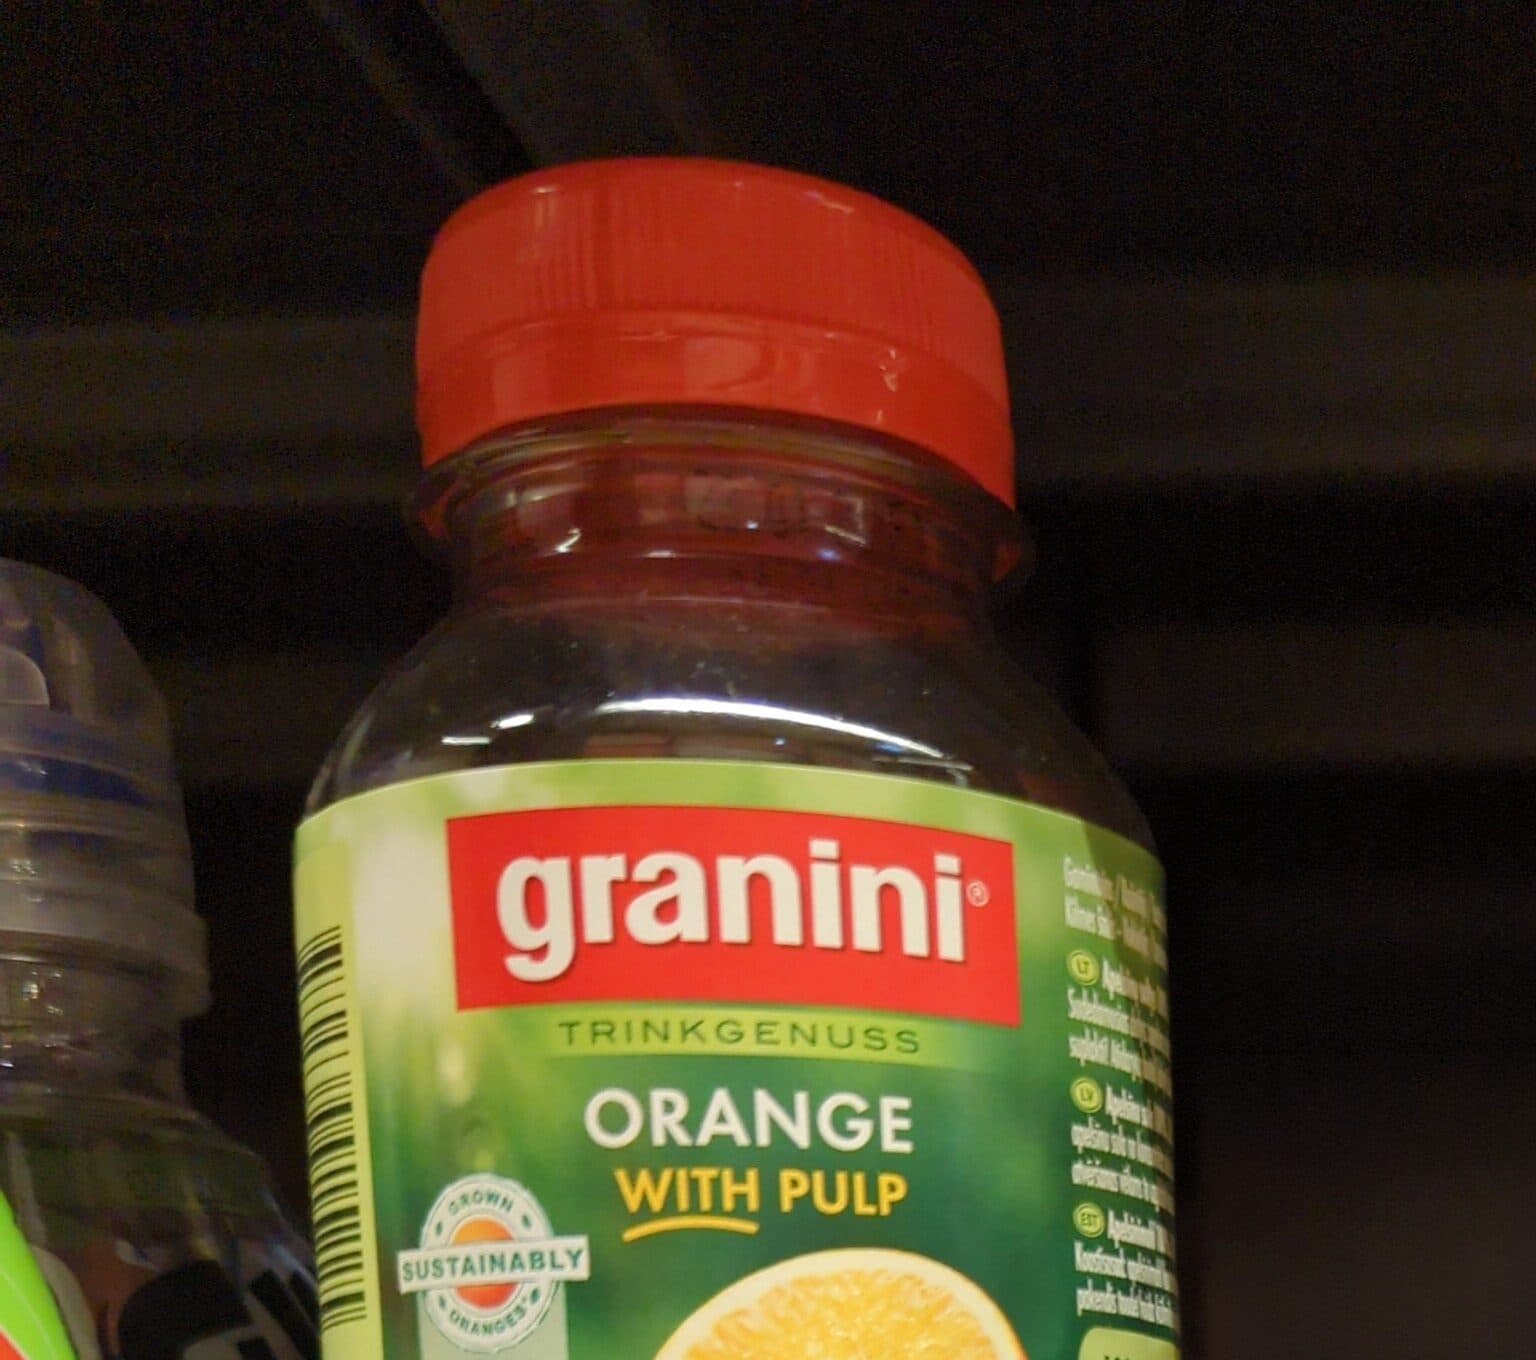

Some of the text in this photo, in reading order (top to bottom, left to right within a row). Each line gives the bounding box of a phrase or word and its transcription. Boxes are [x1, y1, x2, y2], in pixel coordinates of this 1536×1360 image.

[558, 1019, 920, 1054] TRINKGENUSS
[584, 1087, 915, 1154] ORANGE
[447, 1189, 516, 1213] GROWN
[615, 1166, 908, 1218] WITH PULP
[402, 1249, 584, 1283] SUSTAINABLY
